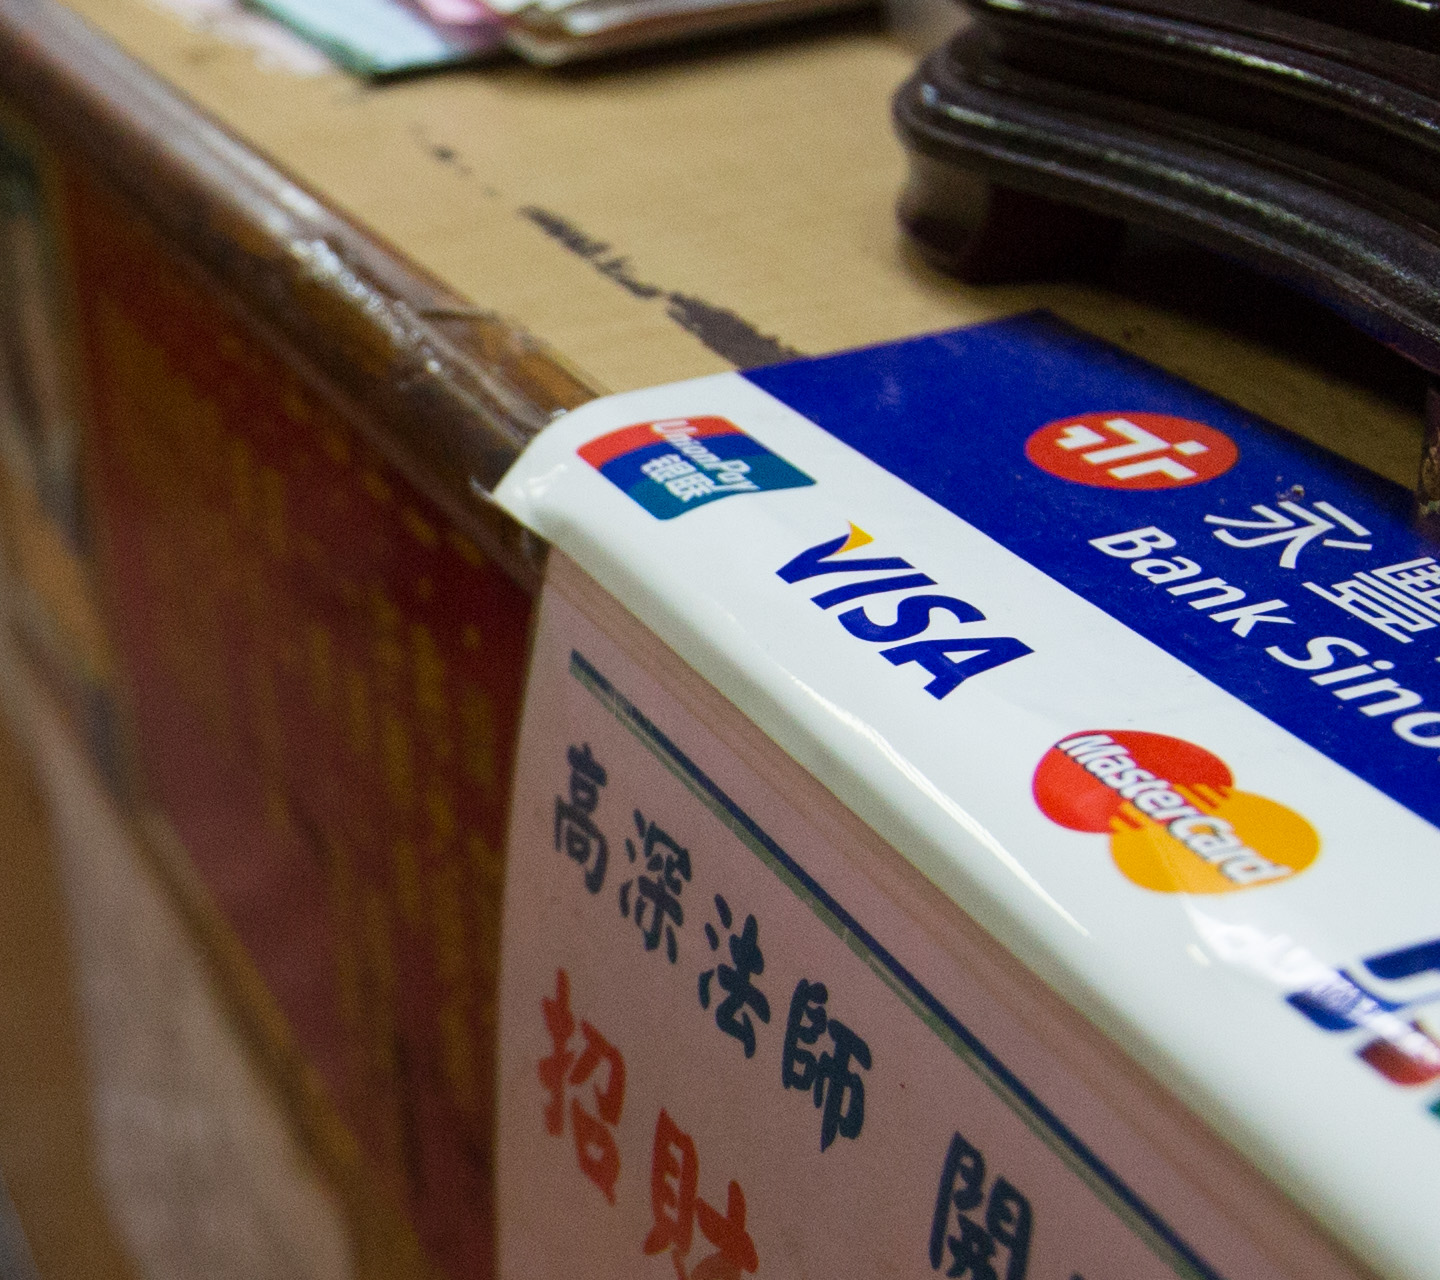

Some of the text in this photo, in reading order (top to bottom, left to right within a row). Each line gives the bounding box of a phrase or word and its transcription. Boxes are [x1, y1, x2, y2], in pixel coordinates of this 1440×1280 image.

[651, 419, 761, 491] UnionPay
[775, 520, 1035, 701] VISA
[1087, 524, 1297, 640] Bank
[1054, 733, 1295, 885] MasterCard
[552, 741, 872, 1154] 高深法師
